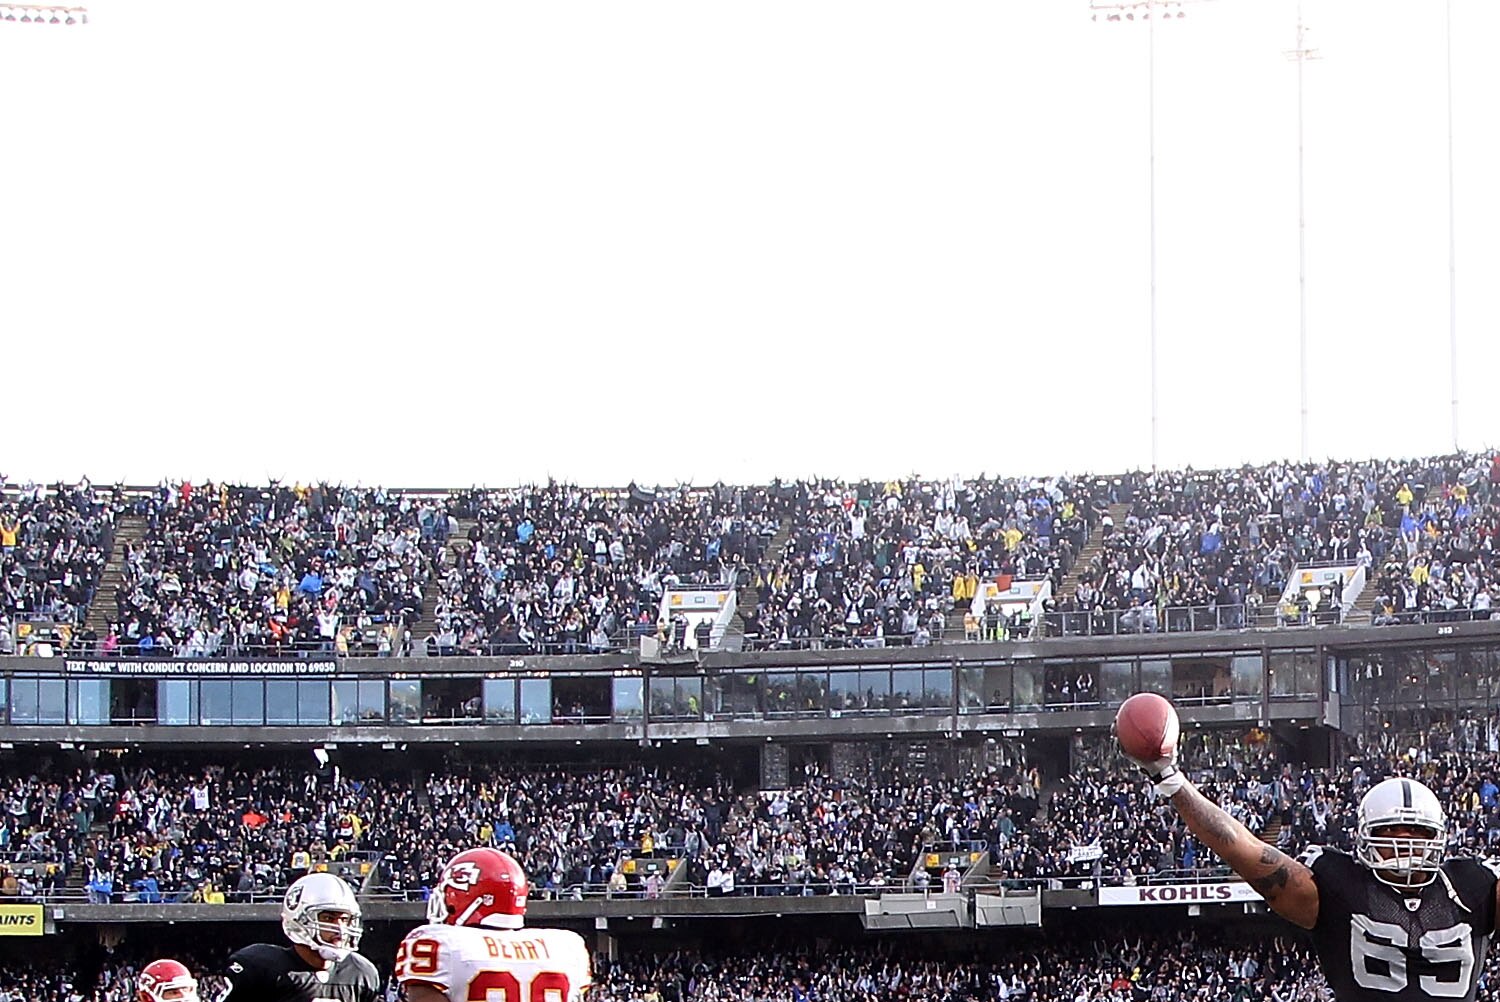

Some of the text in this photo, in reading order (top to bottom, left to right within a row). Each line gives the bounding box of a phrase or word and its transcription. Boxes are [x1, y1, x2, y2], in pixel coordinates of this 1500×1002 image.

[66, 661, 86, 672] TEXT
[118, 662, 141, 673] WITH
[143, 662, 185, 673] CONDUCT
[186, 662, 228, 673] CONCERN
[229, 662, 249, 673] AND
[250, 662, 293, 673] LOCATION
[294, 662, 307, 673] TO
[308, 661, 335, 673] 69050
[1139, 886, 1232, 901] KOHL'S
[484, 936, 550, 960] BERRY
[1350, 913, 1475, 998] 69
